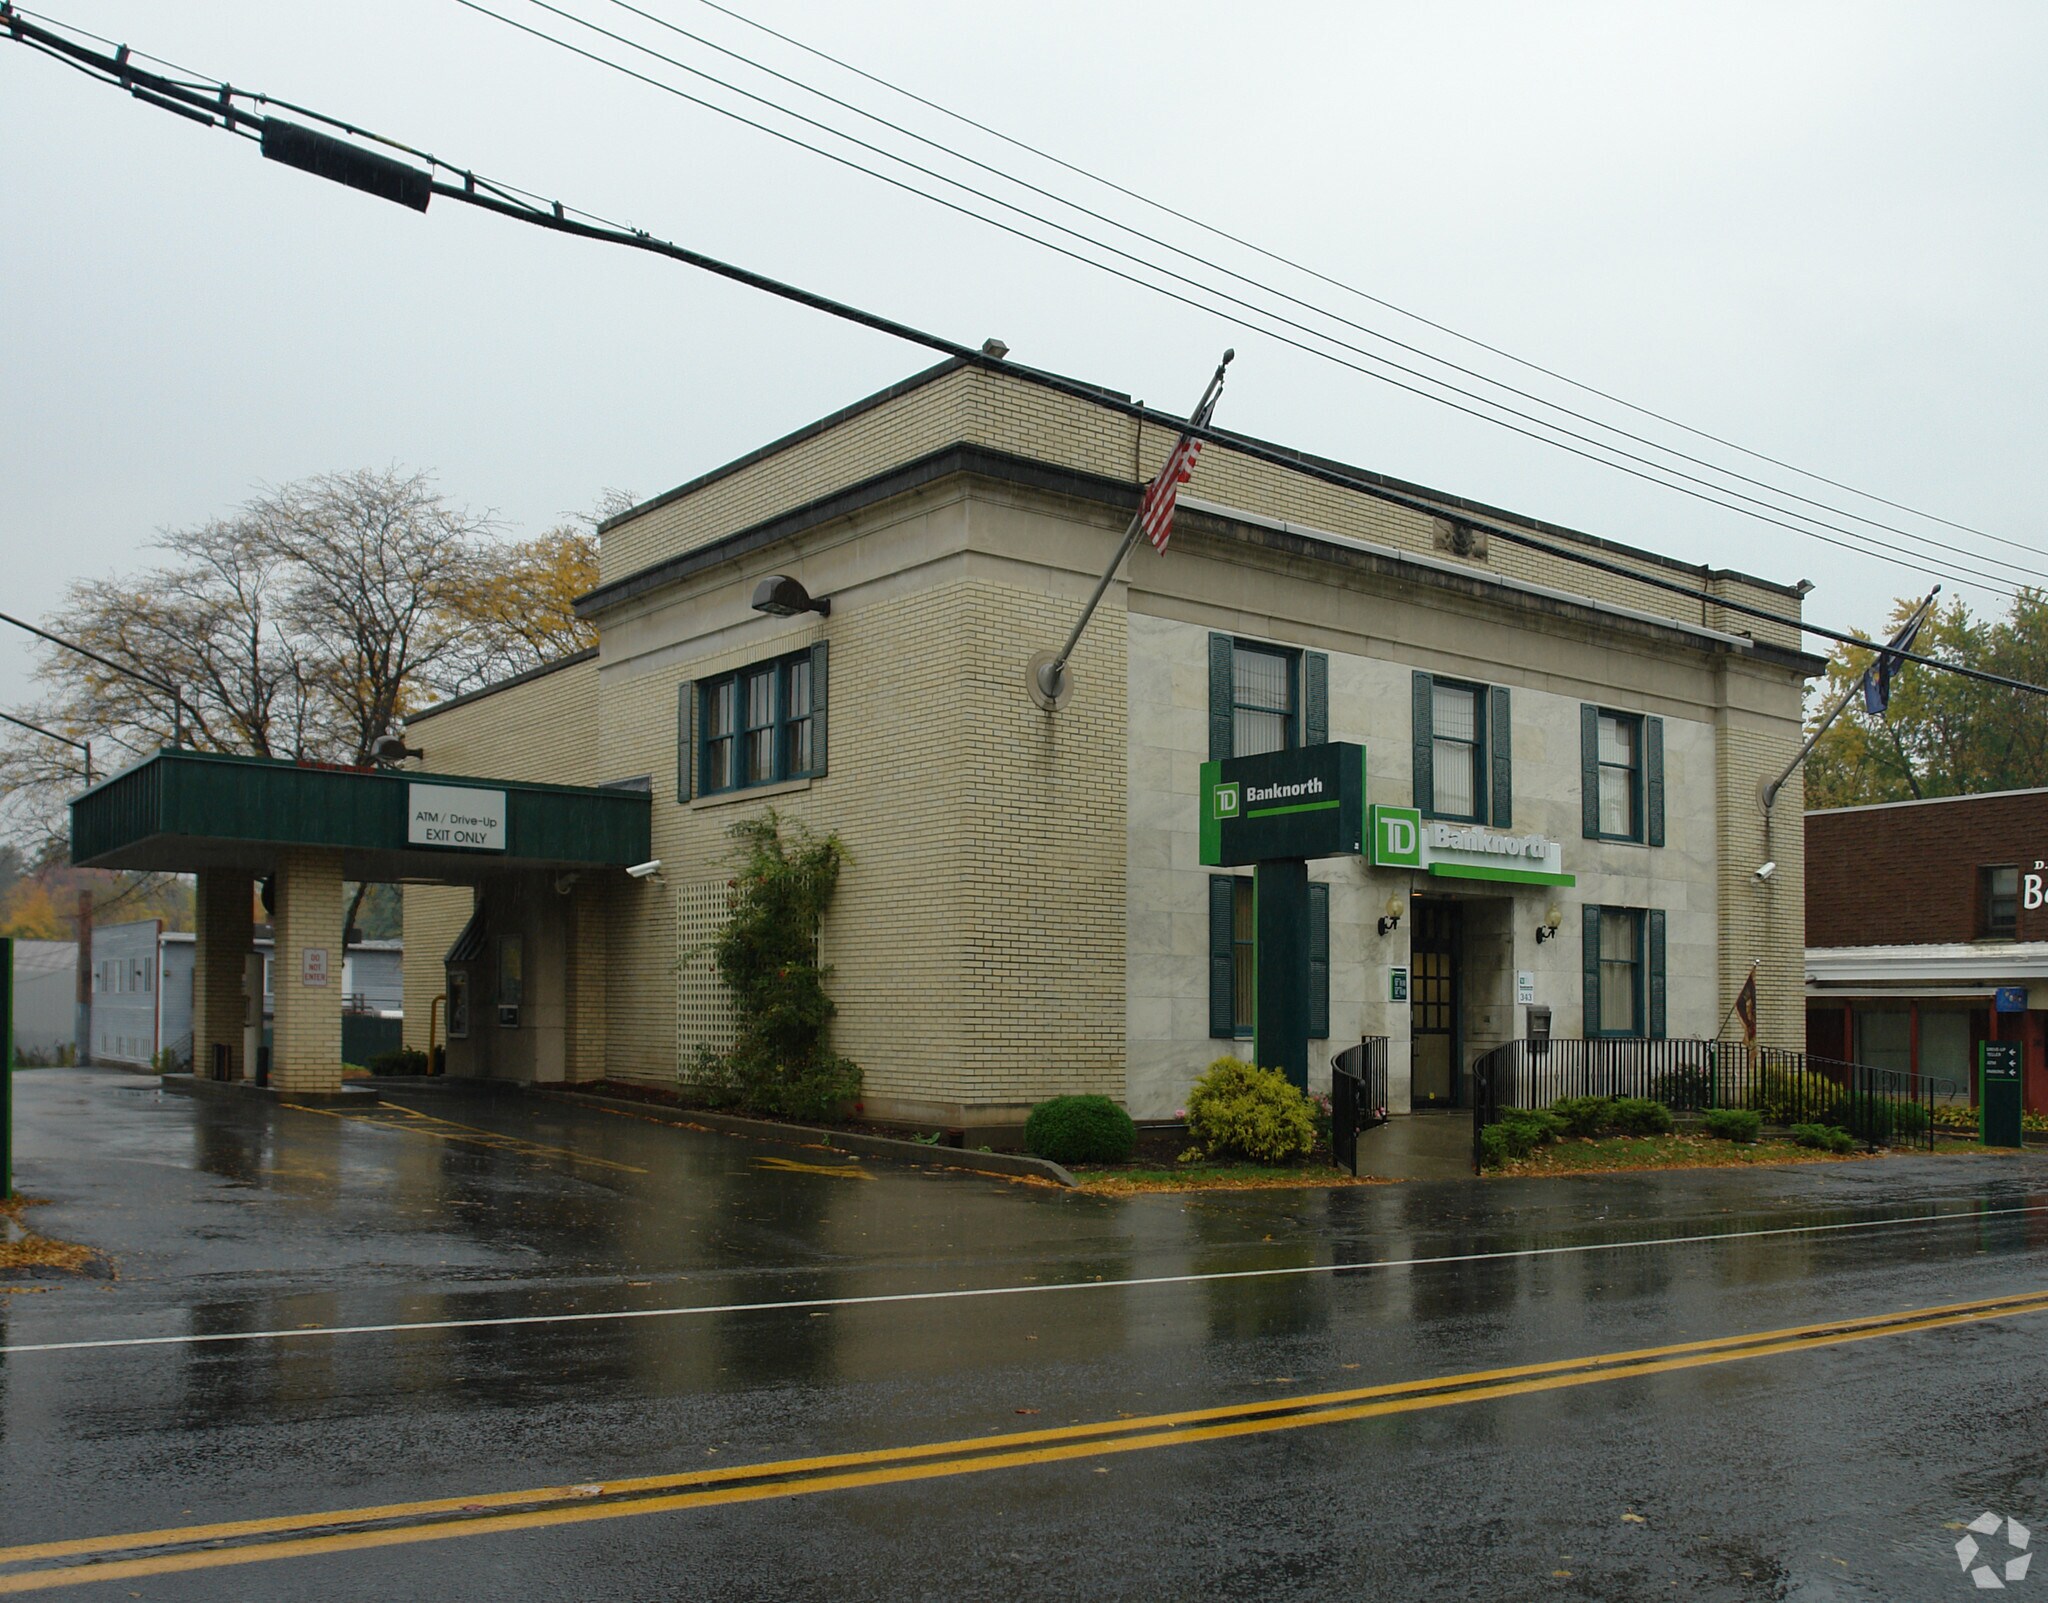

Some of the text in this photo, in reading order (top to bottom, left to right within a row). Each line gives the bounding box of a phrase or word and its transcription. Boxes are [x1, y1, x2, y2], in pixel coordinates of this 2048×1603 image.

[1216, 777, 1323, 812] TD Banknorth
[415, 811, 439, 822] ATM
[449, 814, 497, 829] Drive-Up
[426, 829, 487, 844] EXIT ONLY
[1380, 817, 1548, 859] TD Banknorth
[311, 953, 320, 962] DO
[309, 963, 321, 971] NOT
[304, 973, 326, 981] ENTER
[1520, 992, 1533, 1002] 343
